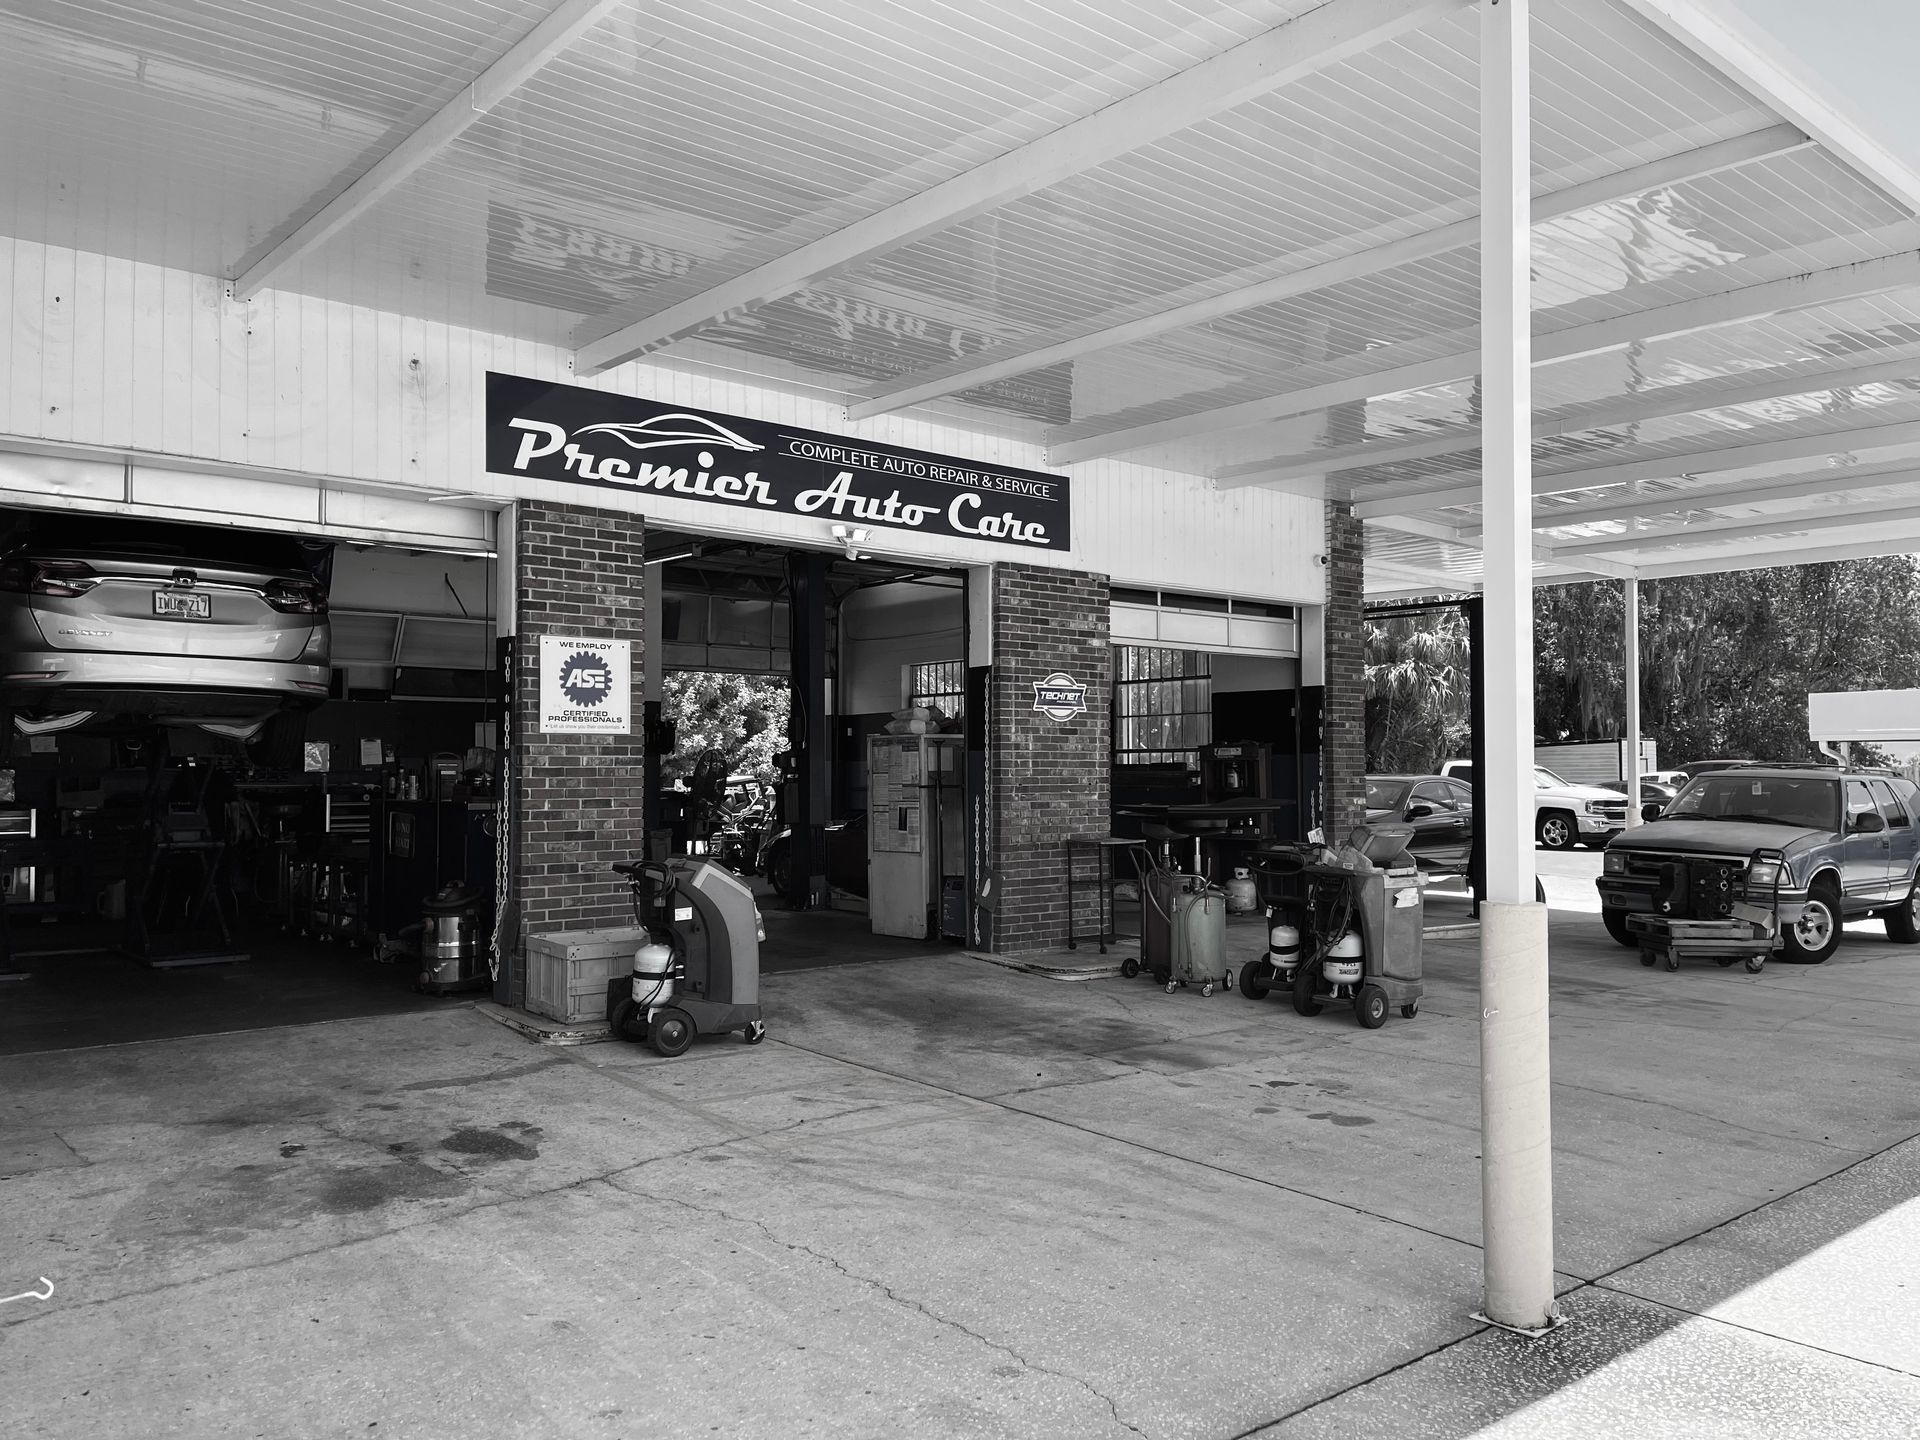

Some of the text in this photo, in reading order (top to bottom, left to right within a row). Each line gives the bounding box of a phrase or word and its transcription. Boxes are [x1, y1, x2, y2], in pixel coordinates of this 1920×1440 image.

[508, 417, 1051, 544] Premier Auto Care
[789, 441, 1050, 498] COMPLETE AUTO REPAIR & SERVICE
[576, 642, 612, 650] EMPLOY
[565, 668, 605, 689] ASE
